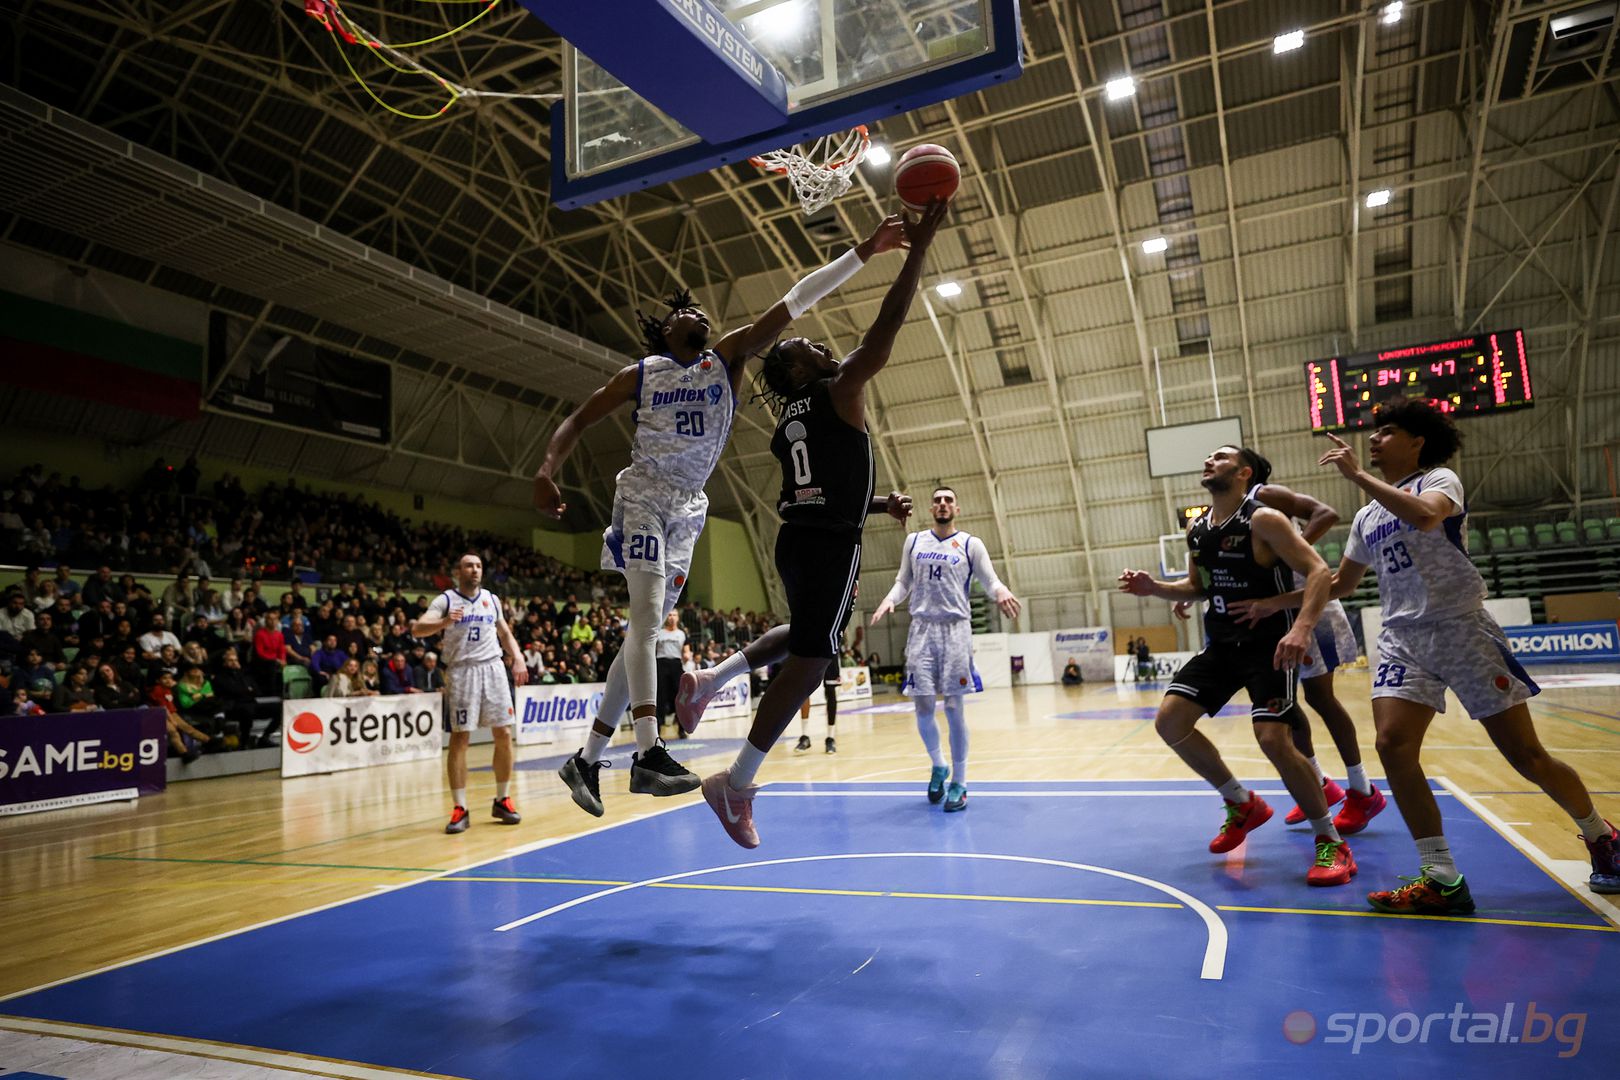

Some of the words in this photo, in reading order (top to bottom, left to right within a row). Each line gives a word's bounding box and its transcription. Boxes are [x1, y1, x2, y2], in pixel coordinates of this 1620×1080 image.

[705, 13, 763, 80] SYSTEM
[1377, 368, 1401, 386] 34
[1430, 359, 1456, 377] 47
[652, 388, 706, 406] bultex
[675, 411, 704, 437] 20
[791, 440, 812, 486] 0
[629, 534, 659, 561] 20
[916, 551, 948, 561] bultex
[1382, 540, 1413, 574] 33
[928, 564, 942, 581] 14
[1212, 594, 1226, 614] 9
[468, 627, 480, 642] 13
[1508, 632, 1613, 653] DECATHLON
[1374, 663, 1406, 688] 33
[456, 709, 467, 725] 13
[522, 696, 588, 724] bultex
[330, 707, 433, 746] stenso
